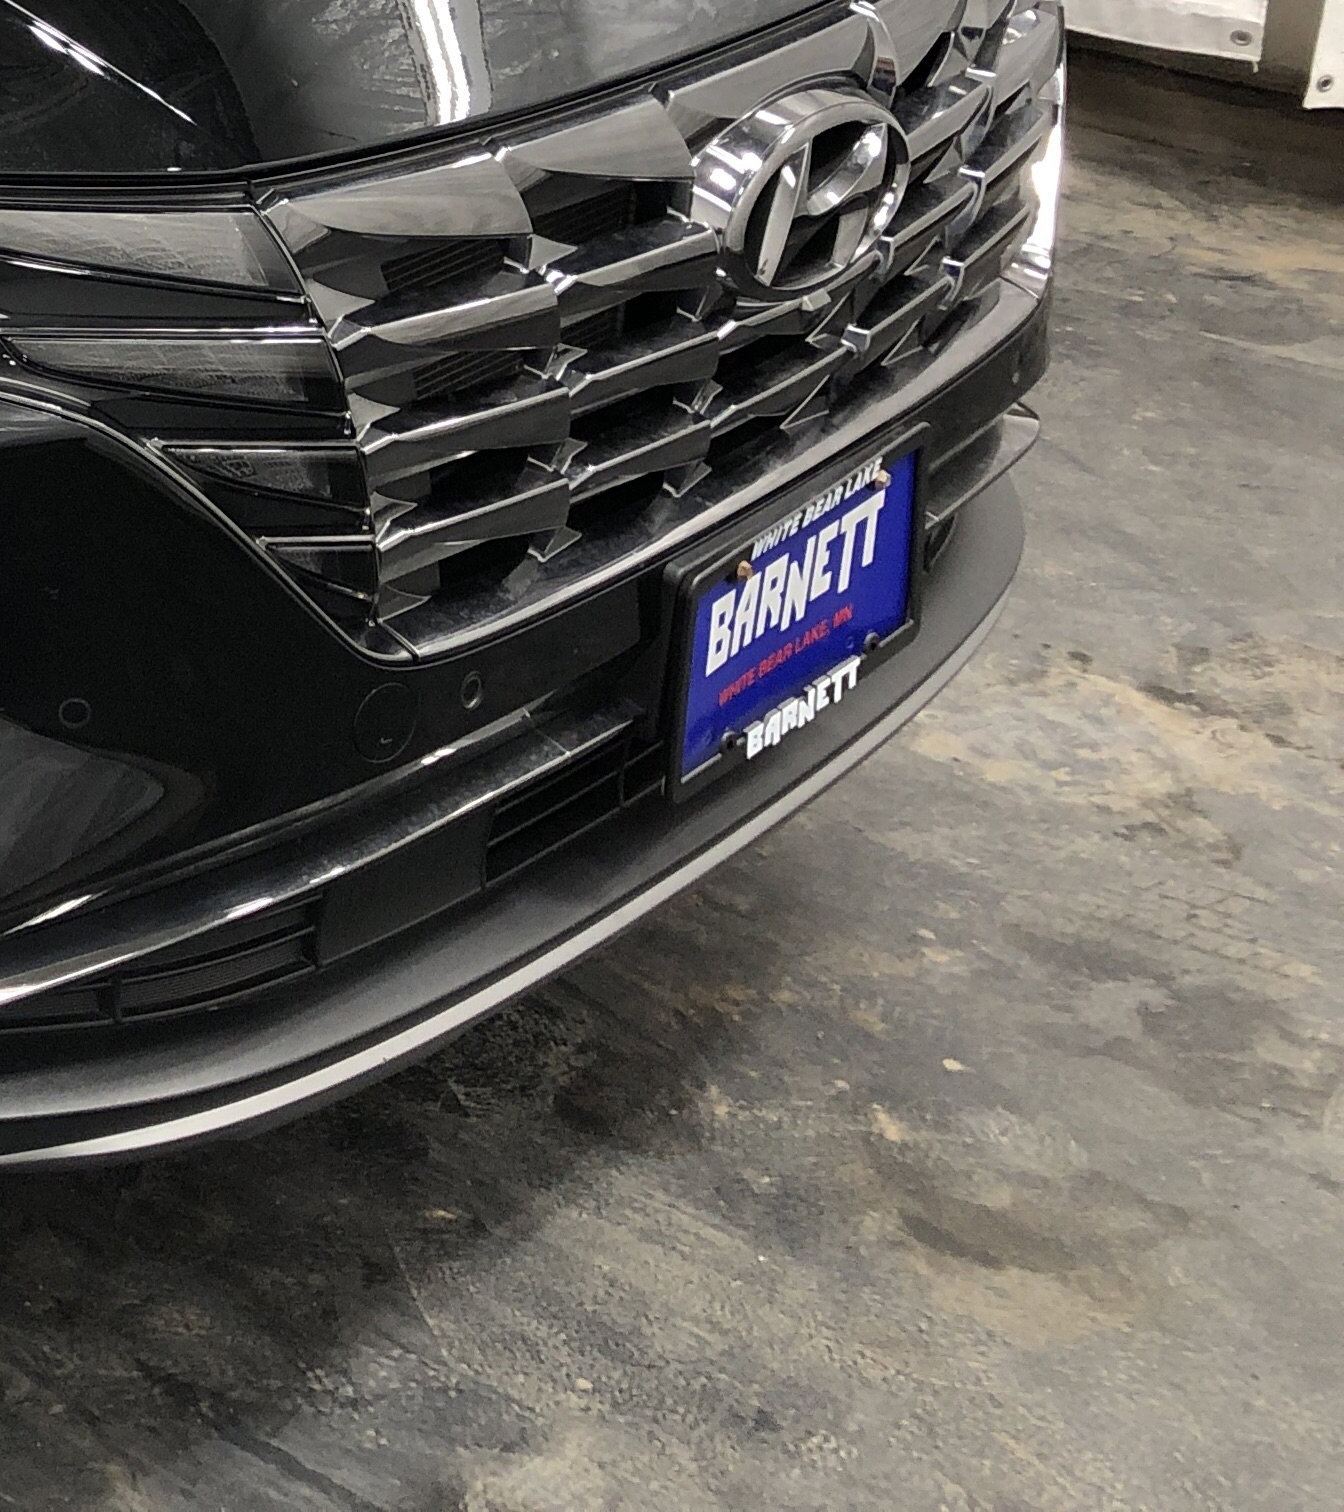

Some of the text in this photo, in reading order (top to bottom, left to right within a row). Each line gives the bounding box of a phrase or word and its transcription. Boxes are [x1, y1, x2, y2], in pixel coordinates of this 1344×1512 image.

[751, 457, 883, 562] WHITE BEAR LAKE
[705, 489, 886, 677] BARNETT
[719, 667, 756, 707] WHITE
[758, 642, 793, 678] BEAR
[832, 603, 853, 628] MN
[743, 655, 861, 761] BARNETT
